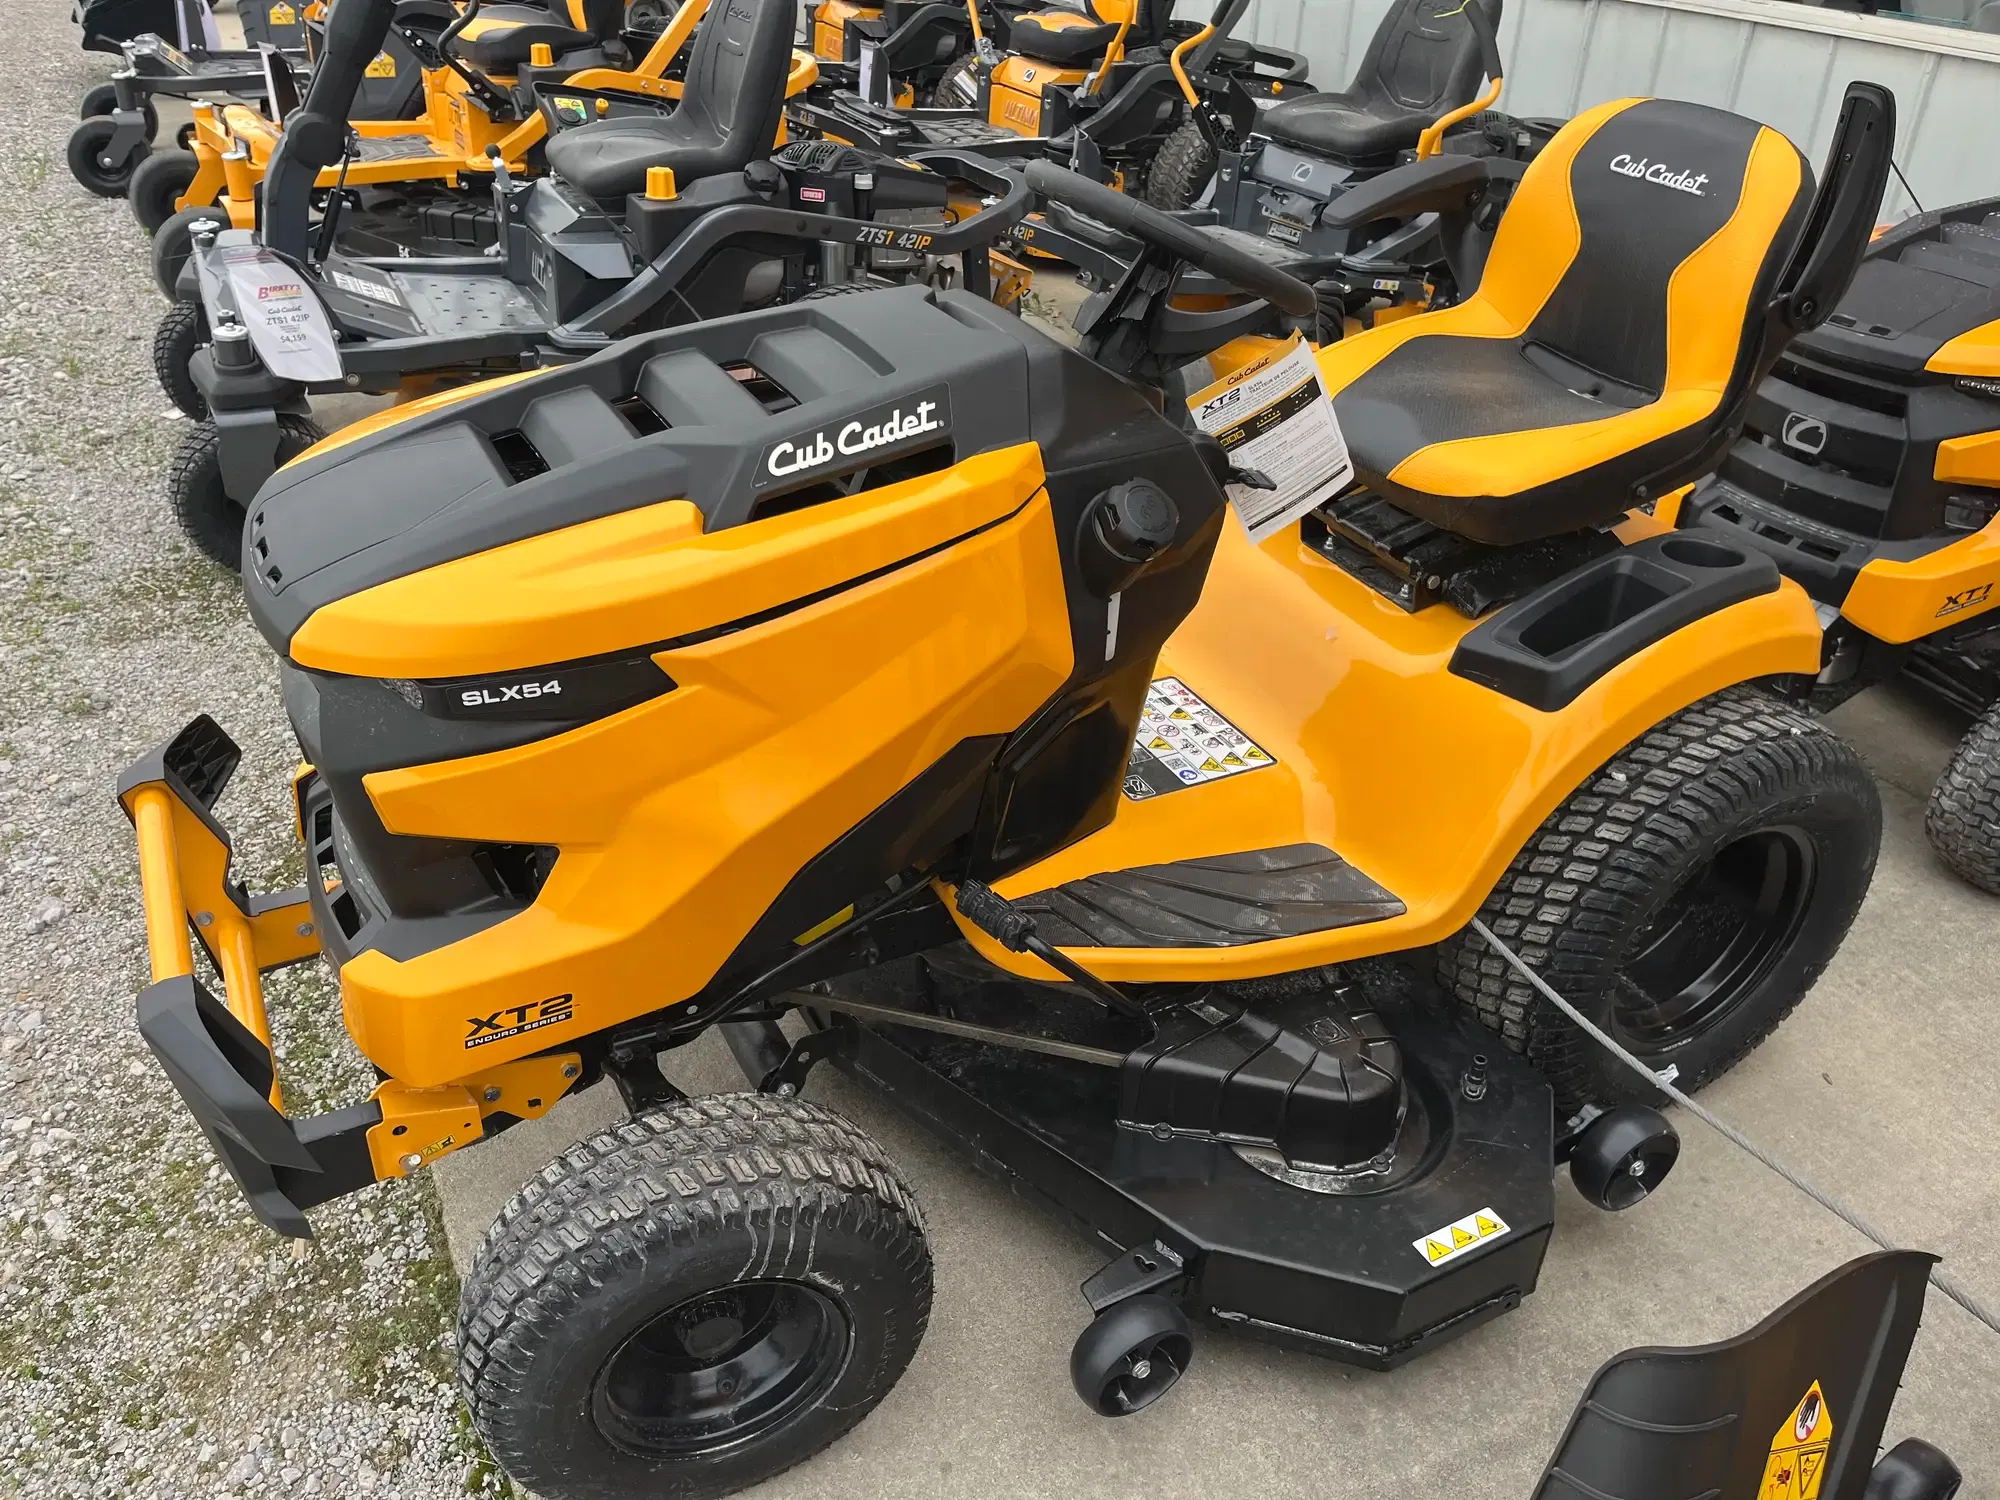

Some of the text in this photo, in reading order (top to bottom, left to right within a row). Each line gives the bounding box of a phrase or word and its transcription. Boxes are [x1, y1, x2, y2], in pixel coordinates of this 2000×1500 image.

[1609, 154, 1709, 196] Cub Cadet
[855, 226, 932, 251] ZTS1 42IP
[1013, 225, 1035, 241] 42IP
[266, 313, 310, 326] ZTS1 42IP
[1227, 372, 1244, 385] Cub
[1244, 357, 1270, 376] Cadet
[1203, 387, 1241, 414] XT2
[768, 401, 938, 477] Cub Cadet
[1940, 582, 1994, 610] XT1
[461, 680, 562, 706] SLX54
[464, 993, 573, 1039] XT2
[467, 1013, 567, 1048] ENDURO SERIES
